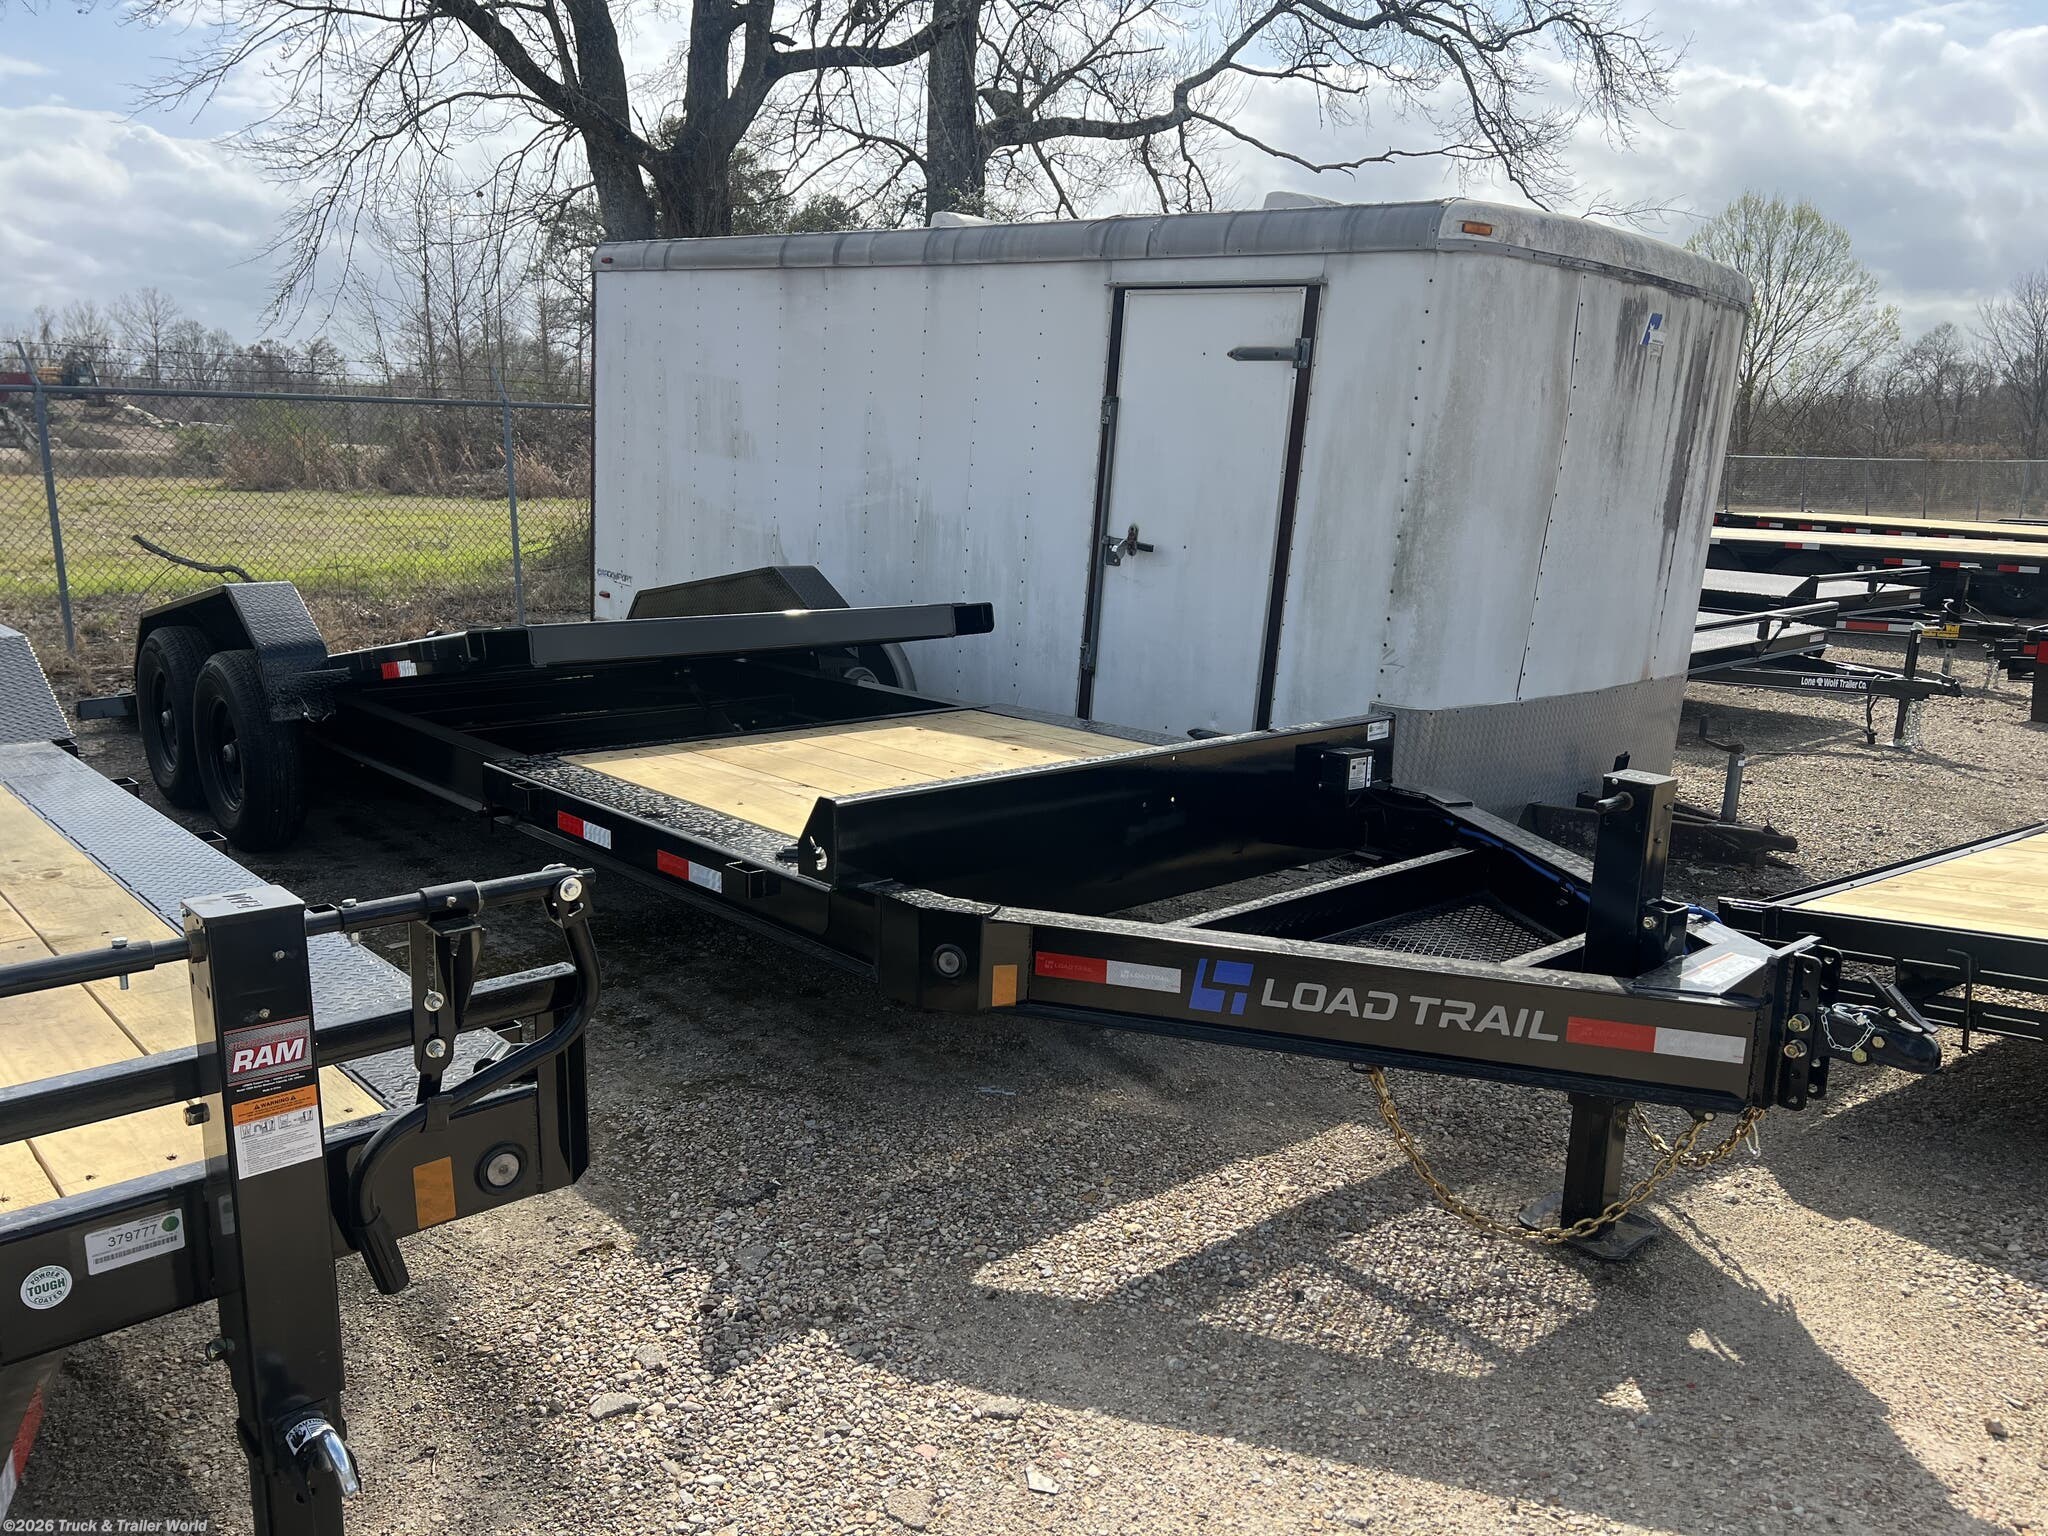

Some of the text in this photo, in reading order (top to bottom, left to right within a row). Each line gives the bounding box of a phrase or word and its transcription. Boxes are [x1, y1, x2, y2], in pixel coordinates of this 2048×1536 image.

[1801, 676, 1867, 690] Lone Wolf Trailer Co.
[1260, 978, 1560, 1043] LOAD TRAIL
[232, 1038, 304, 1073] RAM
[260, 1096, 290, 1108] WARNING
[108, 1224, 158, 1247] 379777
[30, 1271, 60, 1285] POWDER
[27, 1278, 65, 1296] TOUGH
[34, 1290, 62, 1303] COATED
